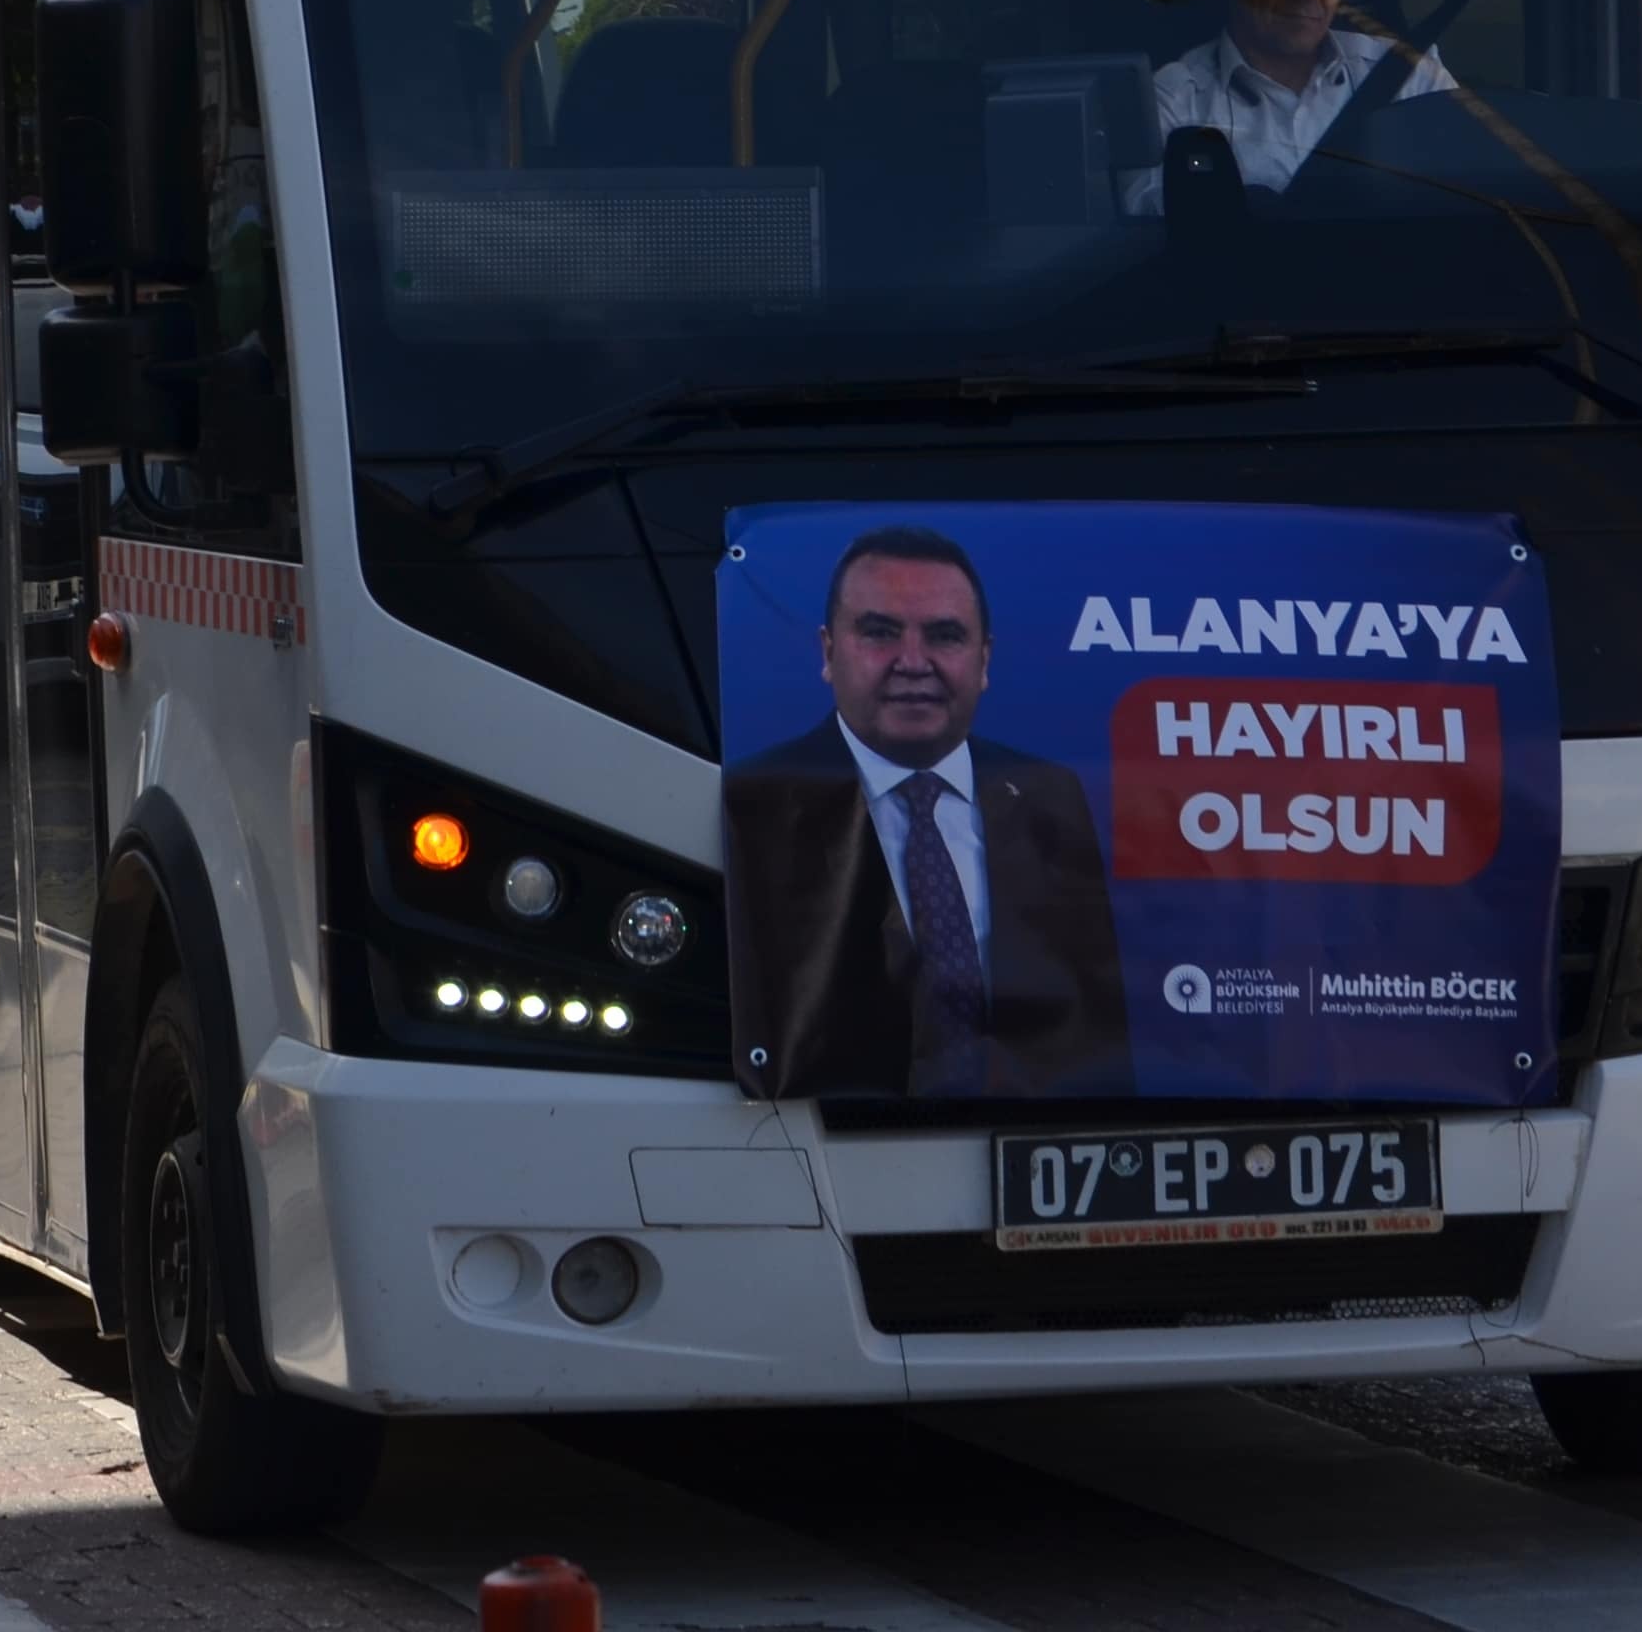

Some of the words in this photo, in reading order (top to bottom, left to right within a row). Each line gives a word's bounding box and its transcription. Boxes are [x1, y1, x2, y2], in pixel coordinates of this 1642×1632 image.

[1069, 596, 1528, 663] ALANYA'YA
[1155, 701, 1466, 763] HAYIRLI
[1179, 791, 1445, 856] OLSUN
[1216, 969, 1274, 981] ANTALYA
[1216, 981, 1300, 999] BÜYÜKŞEHİR
[1320, 973, 1425, 999] Muhittin
[1430, 971, 1518, 1001] BÖCEK
[1216, 999, 1285, 1014] BELEDİYESİ
[1321, 1001, 1363, 1016] Antalya
[1365, 1002, 1424, 1018] Büyükşehir
[1426, 1004, 1473, 1019] Belediye
[1475, 1006, 1518, 1019] Başkanı
[1029, 1144, 1107, 1219] 07
[1152, 1139, 1229, 1213] EP
[1288, 1132, 1406, 1208] 075
